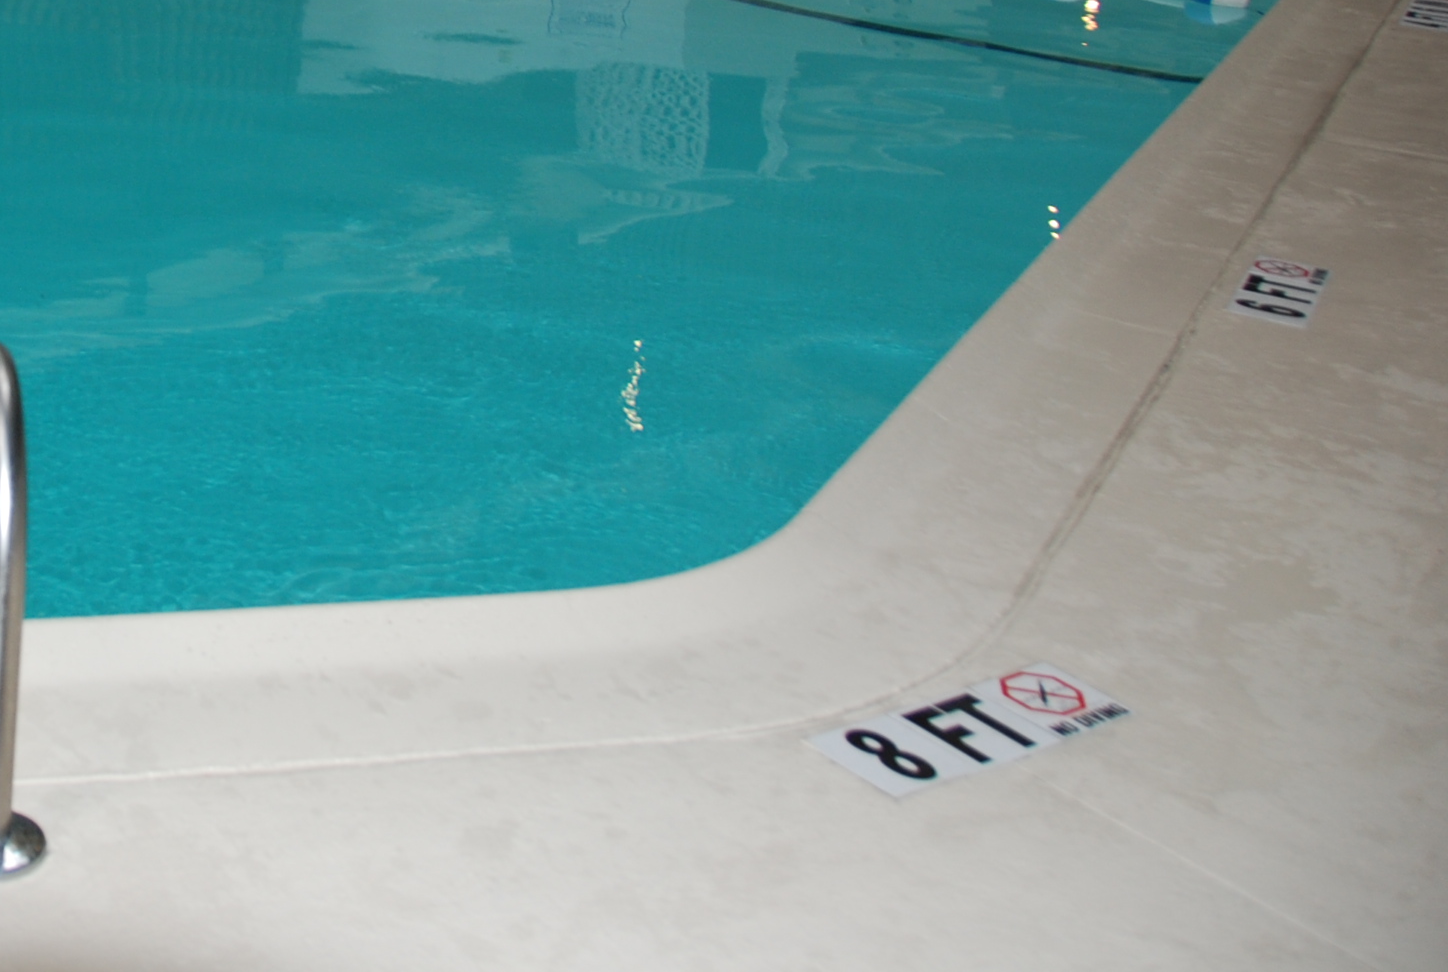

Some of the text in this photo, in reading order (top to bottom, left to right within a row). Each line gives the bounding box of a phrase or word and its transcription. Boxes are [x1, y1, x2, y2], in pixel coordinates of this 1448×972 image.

[1235, 273, 1317, 318] 6 FT
[845, 693, 1037, 780] 8 FT
[1049, 703, 1130, 737] NO DIVING
